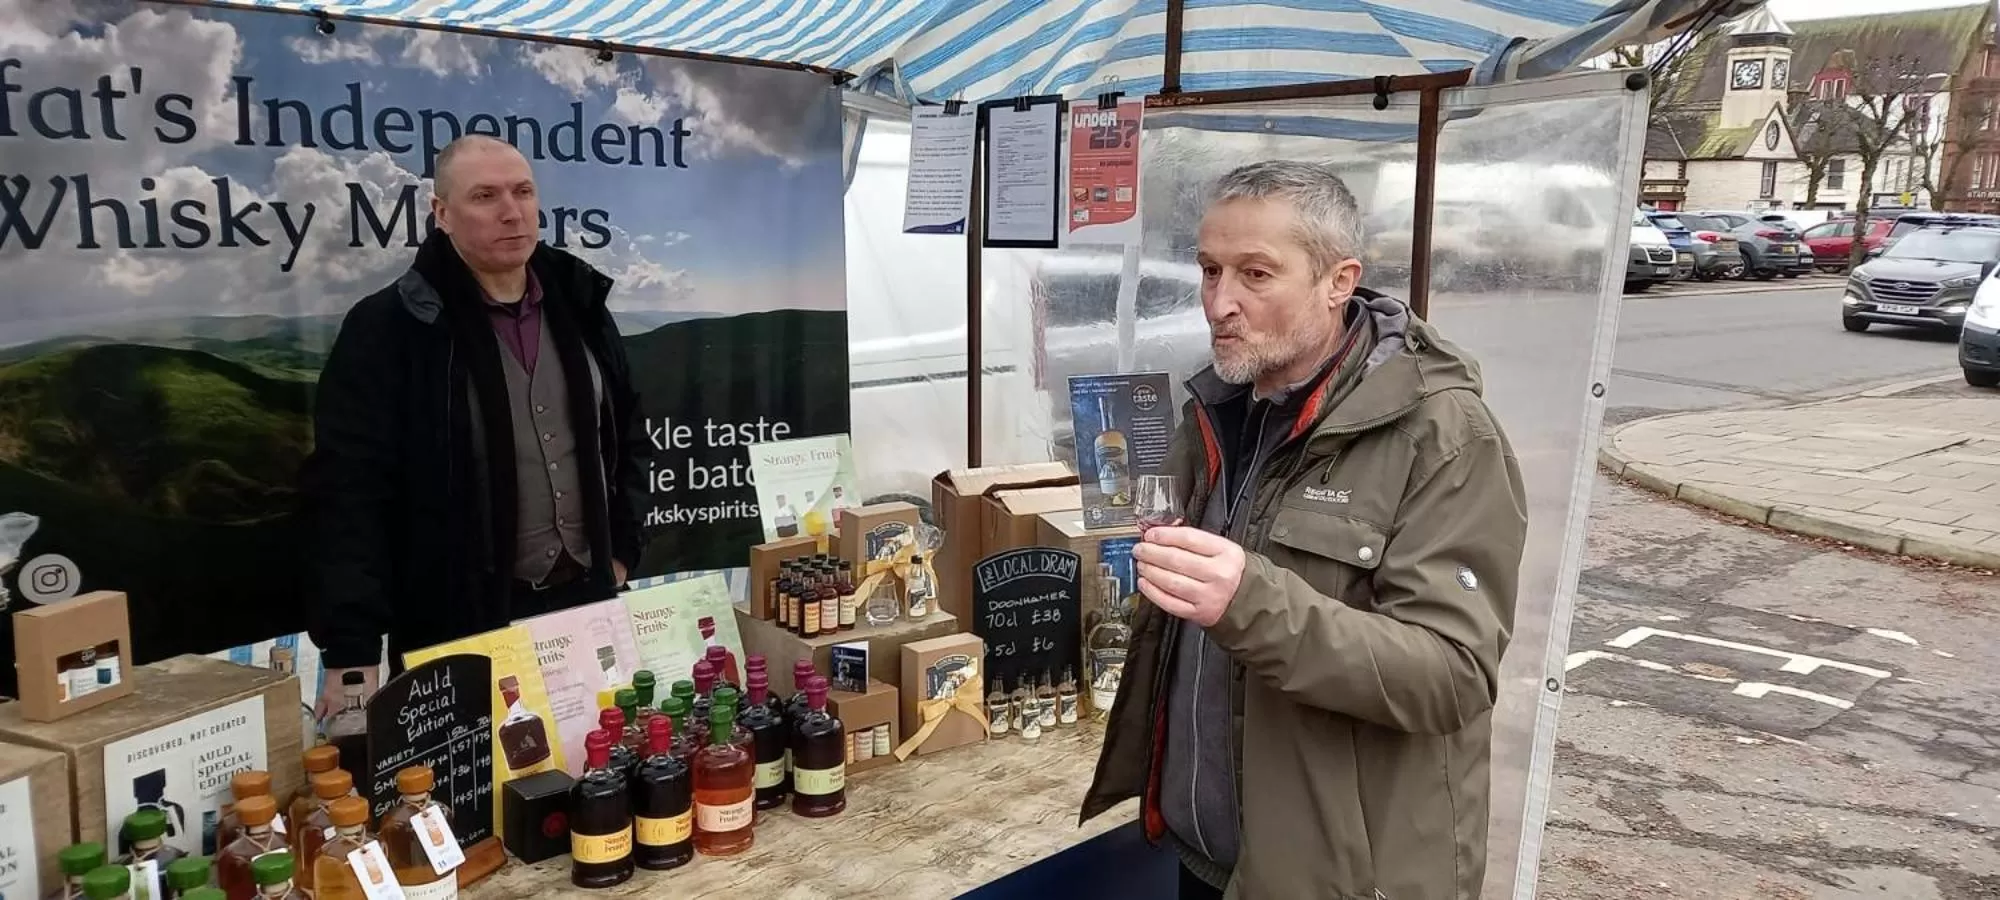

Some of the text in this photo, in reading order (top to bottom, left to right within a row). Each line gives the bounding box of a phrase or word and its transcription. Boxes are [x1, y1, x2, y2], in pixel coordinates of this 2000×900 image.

[0, 58, 690, 179] fat's Independent
[1089, 119, 1140, 150] 25?
[0, 173, 316, 272] Whisky
[704, 416, 791, 447] taste
[644, 500, 760, 526] rkskyspirits
[992, 554, 1038, 581] LOCAL
[1041, 553, 1074, 576] DRAM
[632, 605, 676, 624] Strange
[984, 608, 1062, 629] 70cl £38
[636, 621, 669, 636] Fruits
[535, 633, 573, 652] trange
[1032, 637, 1055, 652] £6
[538, 650, 566, 667] ruits
[408, 665, 452, 701] Auld
[397, 686, 456, 726] Special
[190, 729, 207, 742] NOT
[210, 715, 246, 736] CREATED
[407, 712, 454, 743] Edition
[198, 745, 232, 764] AULD
[198, 752, 252, 778] SPECIAL
[376, 746, 415, 771] VARIETY
